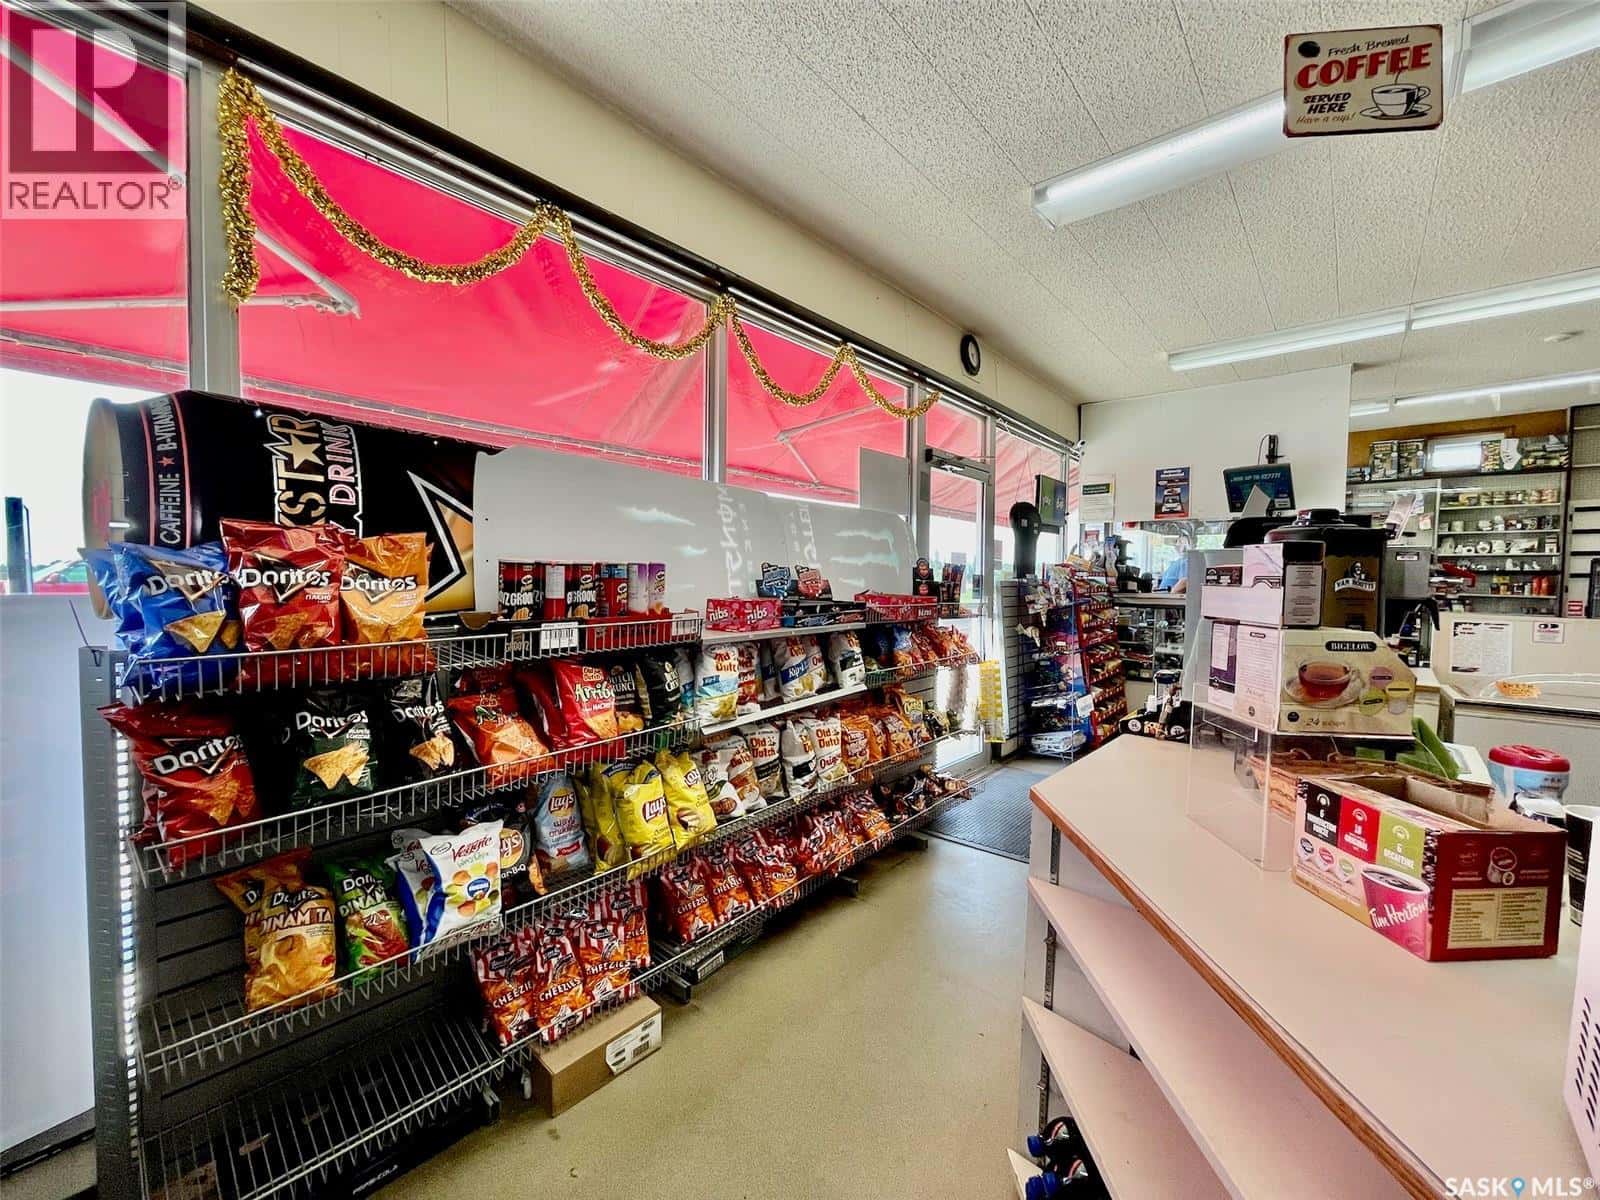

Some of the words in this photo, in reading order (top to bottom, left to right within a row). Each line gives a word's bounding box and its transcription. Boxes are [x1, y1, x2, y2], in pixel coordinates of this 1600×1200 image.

[1328, 42, 1361, 57] Fresh
[1365, 35, 1410, 52] Brewed
[1295, 43, 1433, 90] COFFEE
[1304, 92, 1352, 104] SERVED
[1307, 102, 1348, 114] HERE
[1296, 114, 1321, 125] Have
[1332, 112, 1357, 124] cup!
[322, 422, 356, 505] DRINK
[159, 473, 181, 544] CAFFEINE
[146, 569, 229, 596] Doritos
[240, 568, 332, 588] Doritos
[340, 575, 417, 591] Doritos
[709, 608, 729, 622] nibs
[747, 606, 768, 624] nibs
[295, 710, 369, 730] Doritos
[816, 728, 831, 738] Old
[750, 737, 767, 750] Old
[154, 734, 242, 774] Doritos
[261, 907, 332, 935] DINAMTA
[1369, 907, 1390, 929] Tim
[539, 977, 582, 1002] CHEEZIES
